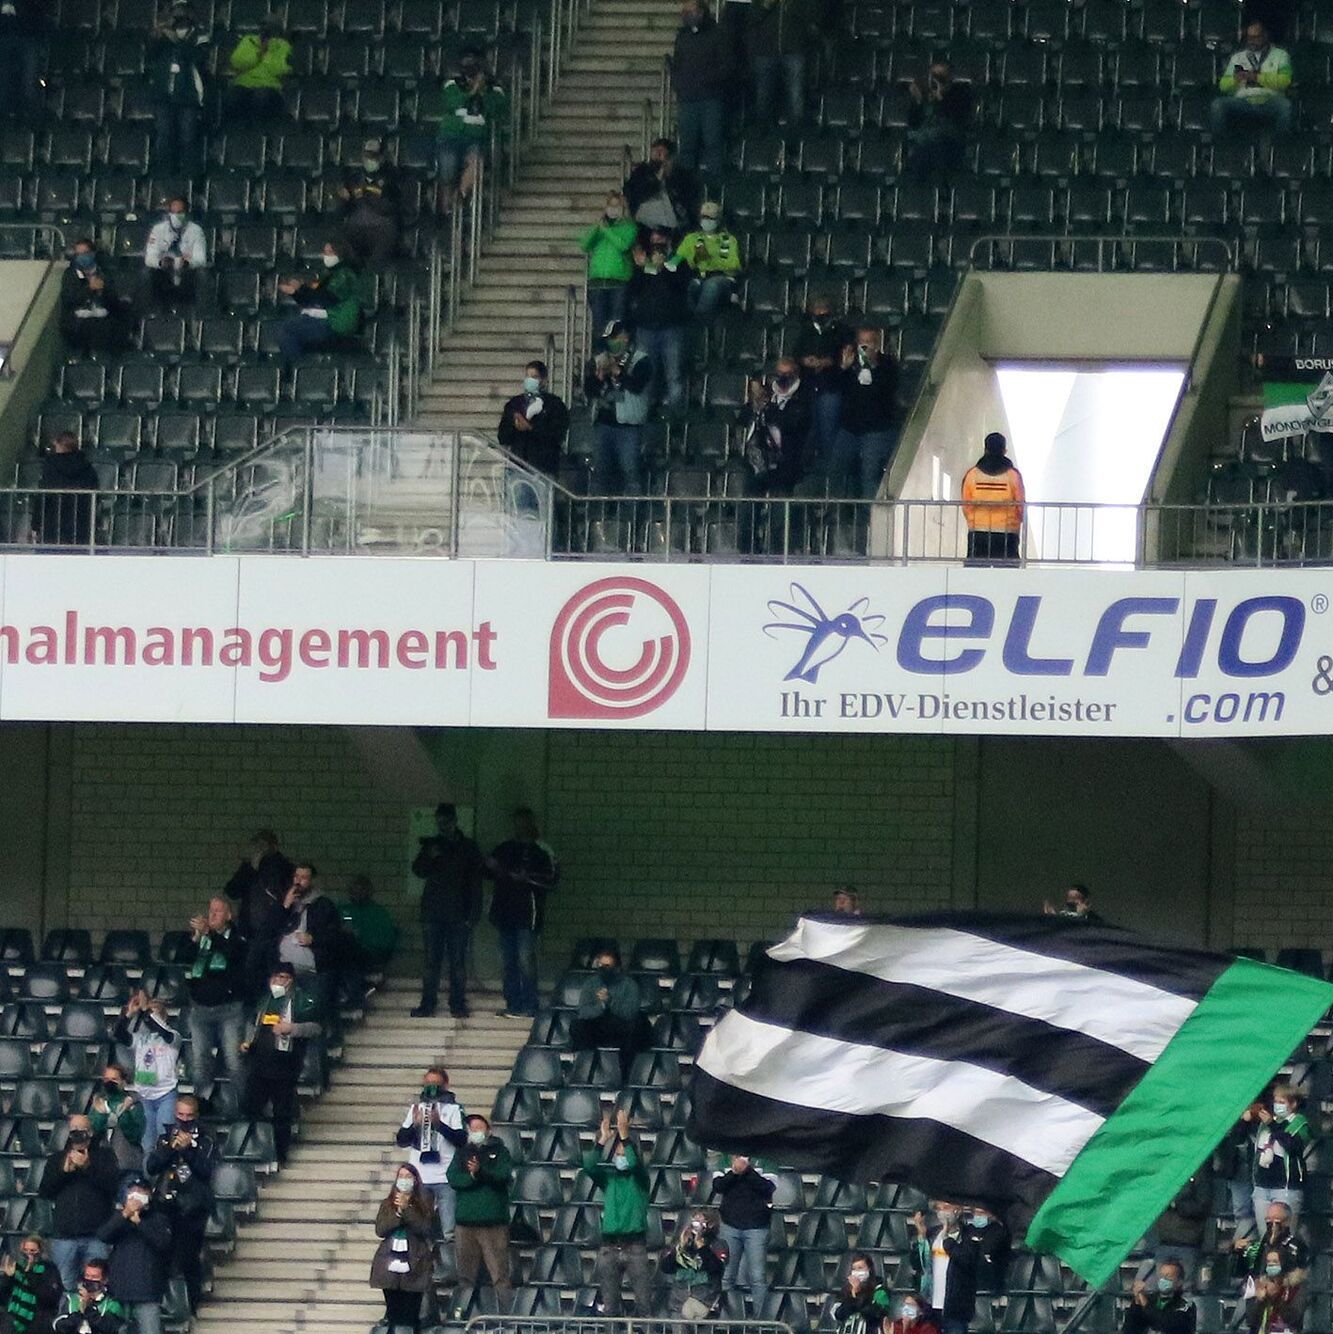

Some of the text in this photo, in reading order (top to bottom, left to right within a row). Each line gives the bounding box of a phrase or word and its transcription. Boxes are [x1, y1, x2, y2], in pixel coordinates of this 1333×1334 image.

[780, 692, 1117, 722] Ihr EDV-Dienstleister
[1165, 692, 1285, 723] .com
